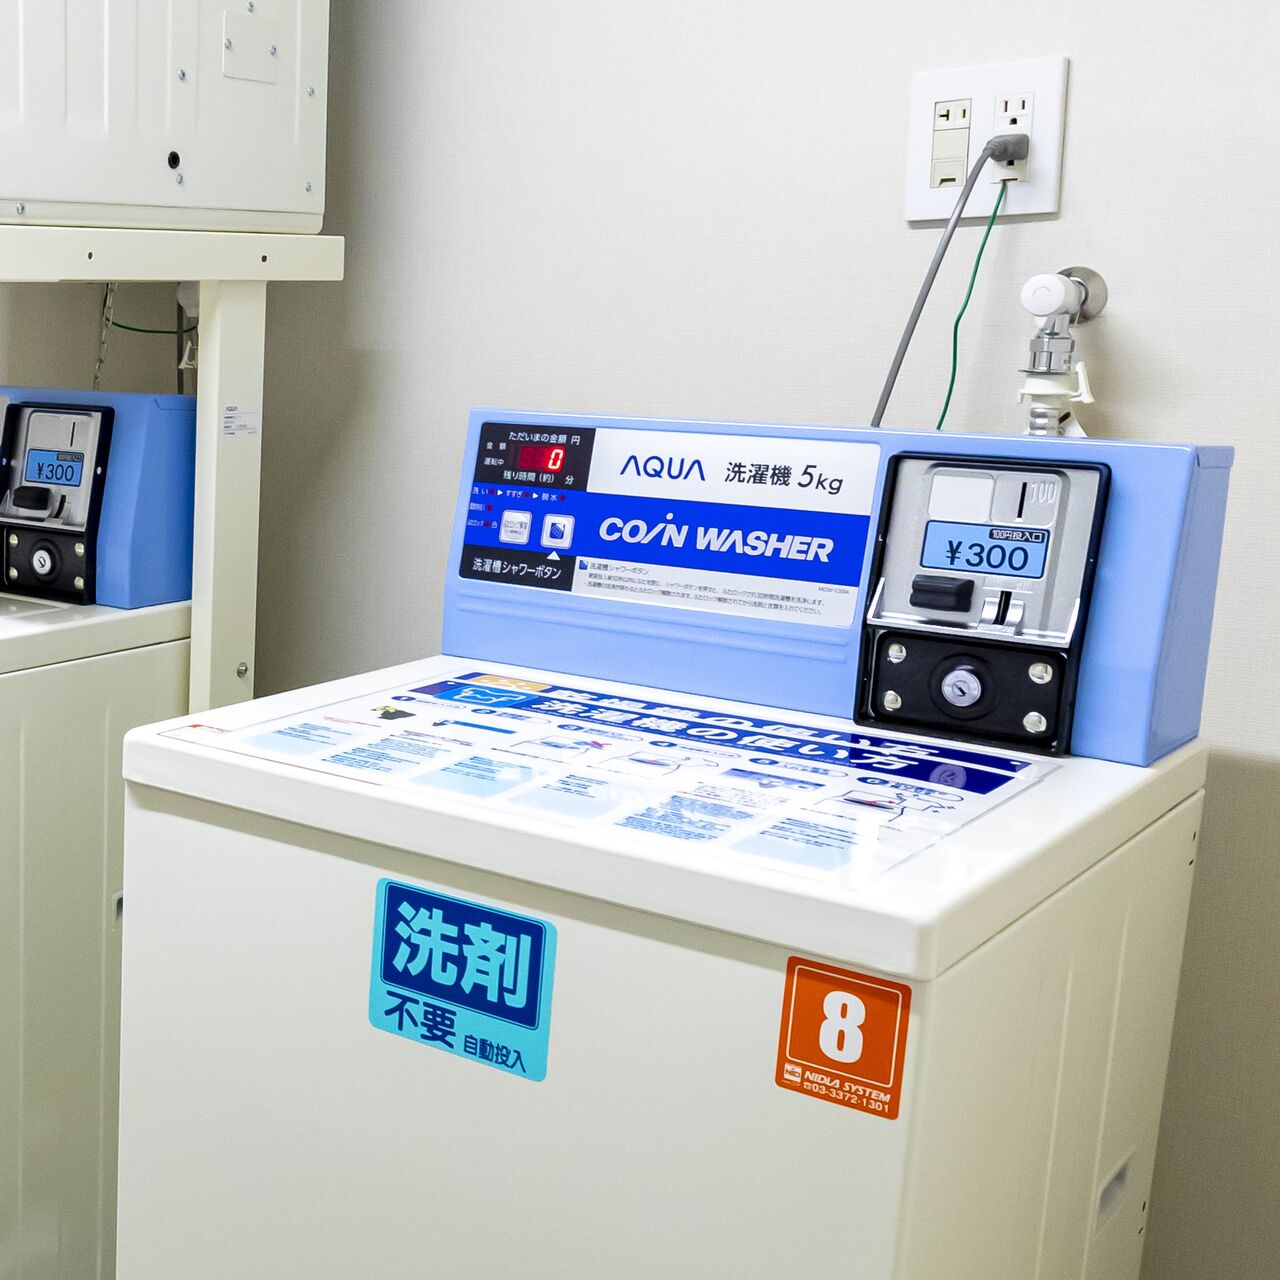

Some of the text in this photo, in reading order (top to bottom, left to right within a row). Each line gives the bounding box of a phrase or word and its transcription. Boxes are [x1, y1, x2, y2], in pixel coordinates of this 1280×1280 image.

[508, 431, 581, 446] ただいまの金額 円
[36, 462, 75, 482] ¥300
[547, 448, 564, 470] 0
[564, 475, 575, 485] 分
[619, 455, 844, 495] AQUA 洗濯機 5kg
[695, 526, 835, 563] WASHER
[992, 529, 1043, 543] 100円投入口
[472, 557, 562, 580] 洗濯槽シャワーボタン
[945, 540, 1030, 571] ¥300
[531, 700, 919, 770] 洗濯機の使い方
[392, 901, 532, 1009] 洗剤
[384, 990, 457, 1049] 不要
[818, 990, 866, 1063] 8
[464, 1034, 527, 1074] 自動投入
[843, 1082, 891, 1103] SYSTEM
